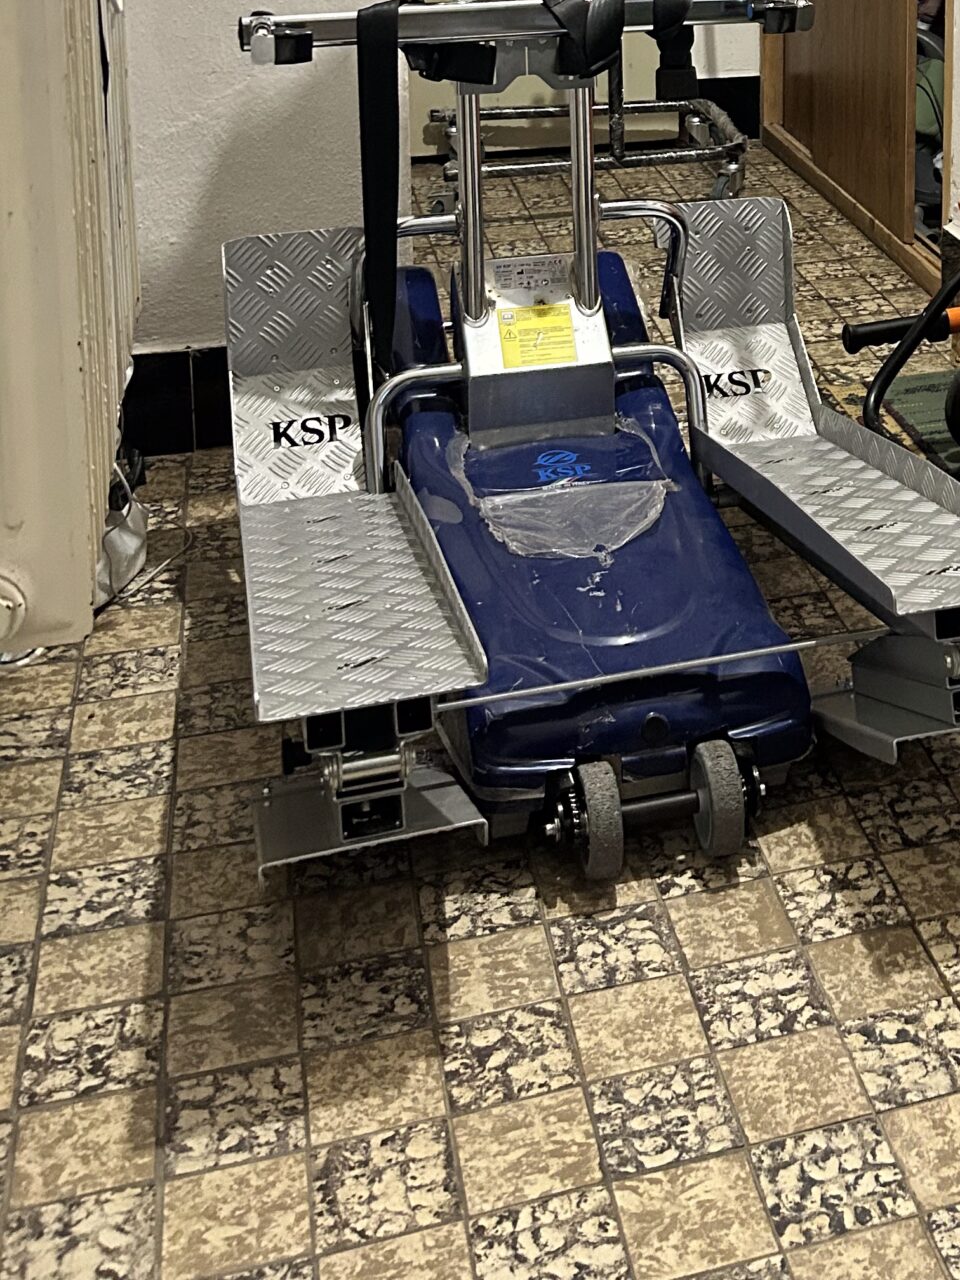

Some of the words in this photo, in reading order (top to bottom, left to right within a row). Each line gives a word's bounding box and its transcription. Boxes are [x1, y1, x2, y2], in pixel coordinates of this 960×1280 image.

[701, 368, 773, 399] KSP
[270, 414, 352, 450] KSP
[537, 464, 592, 482] KSP
